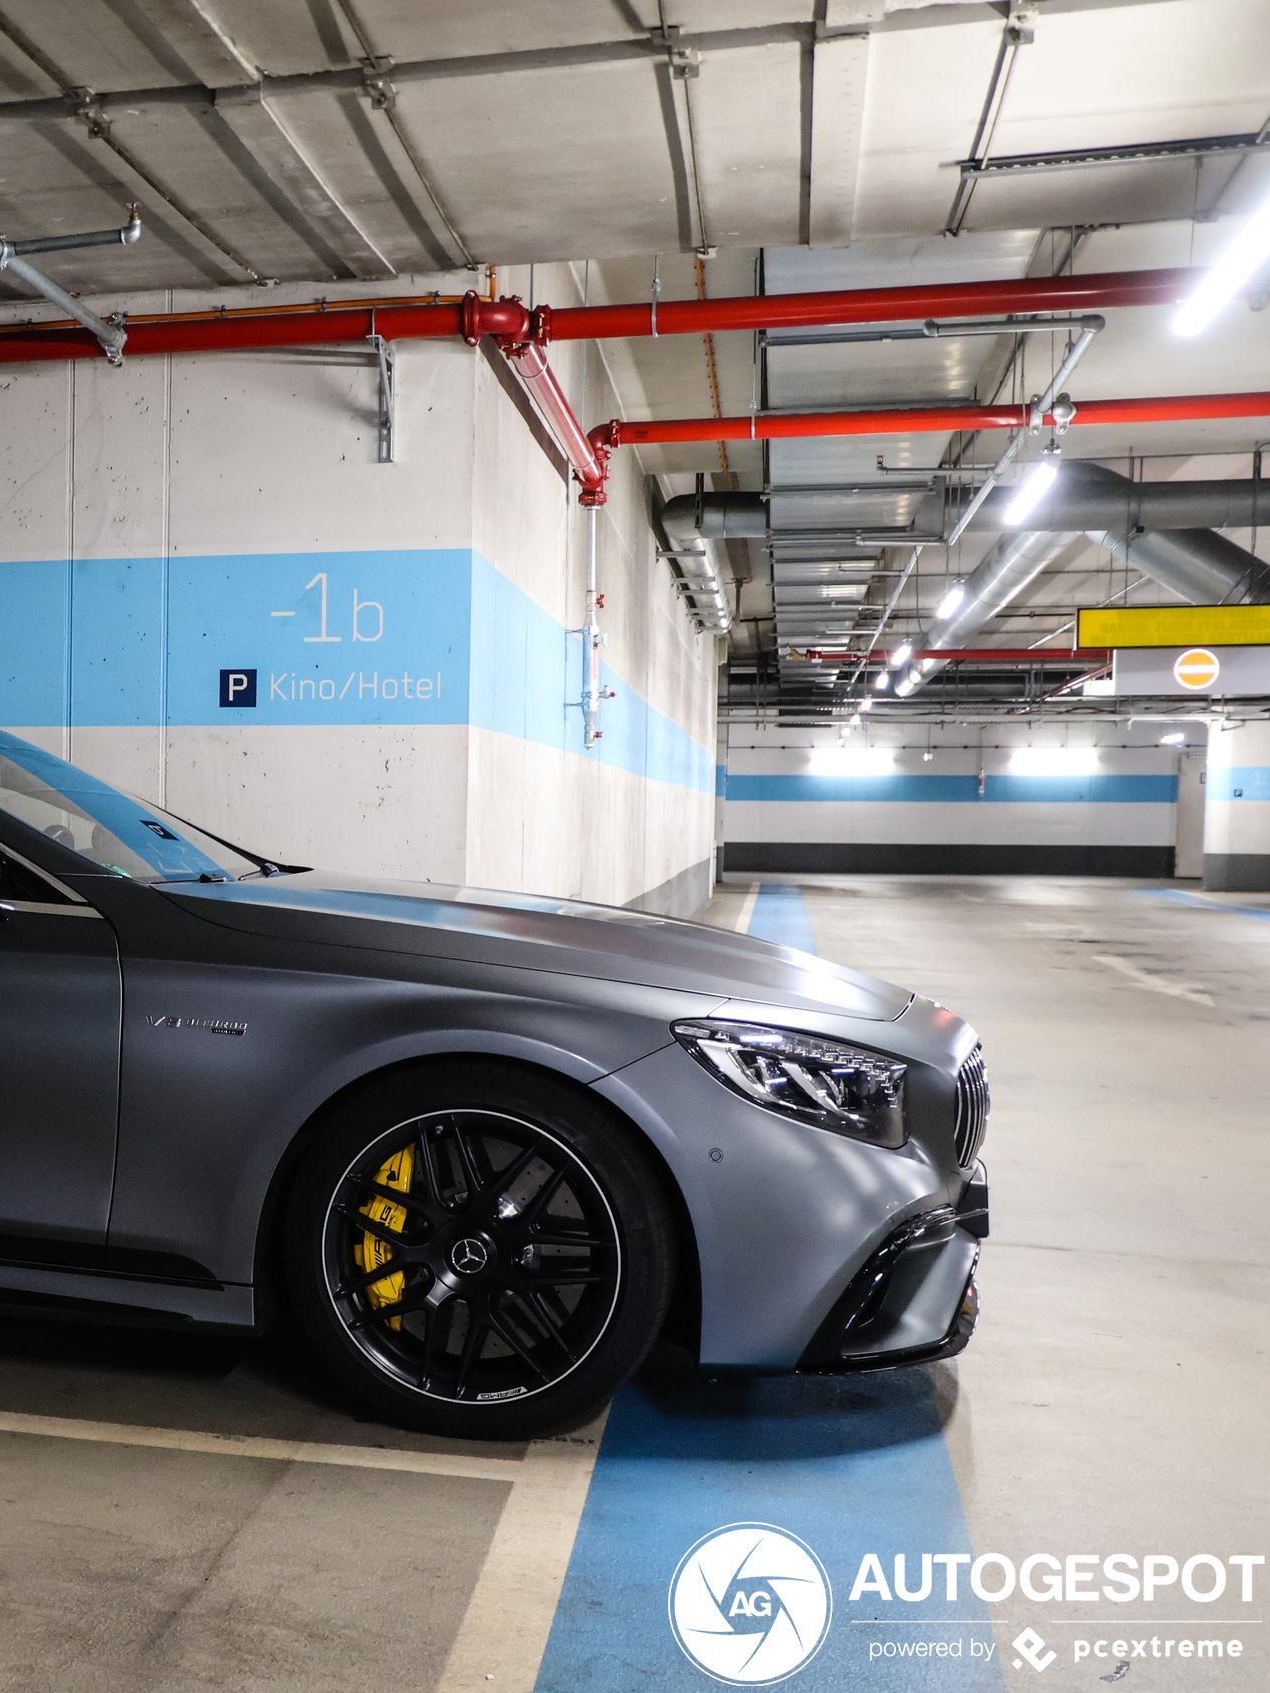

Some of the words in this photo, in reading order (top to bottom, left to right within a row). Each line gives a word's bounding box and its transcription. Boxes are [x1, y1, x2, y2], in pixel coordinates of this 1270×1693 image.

[271, 573, 384, 642] -1b
[229, 674, 248, 701] P
[271, 672, 441, 699] Kino/Hotel
